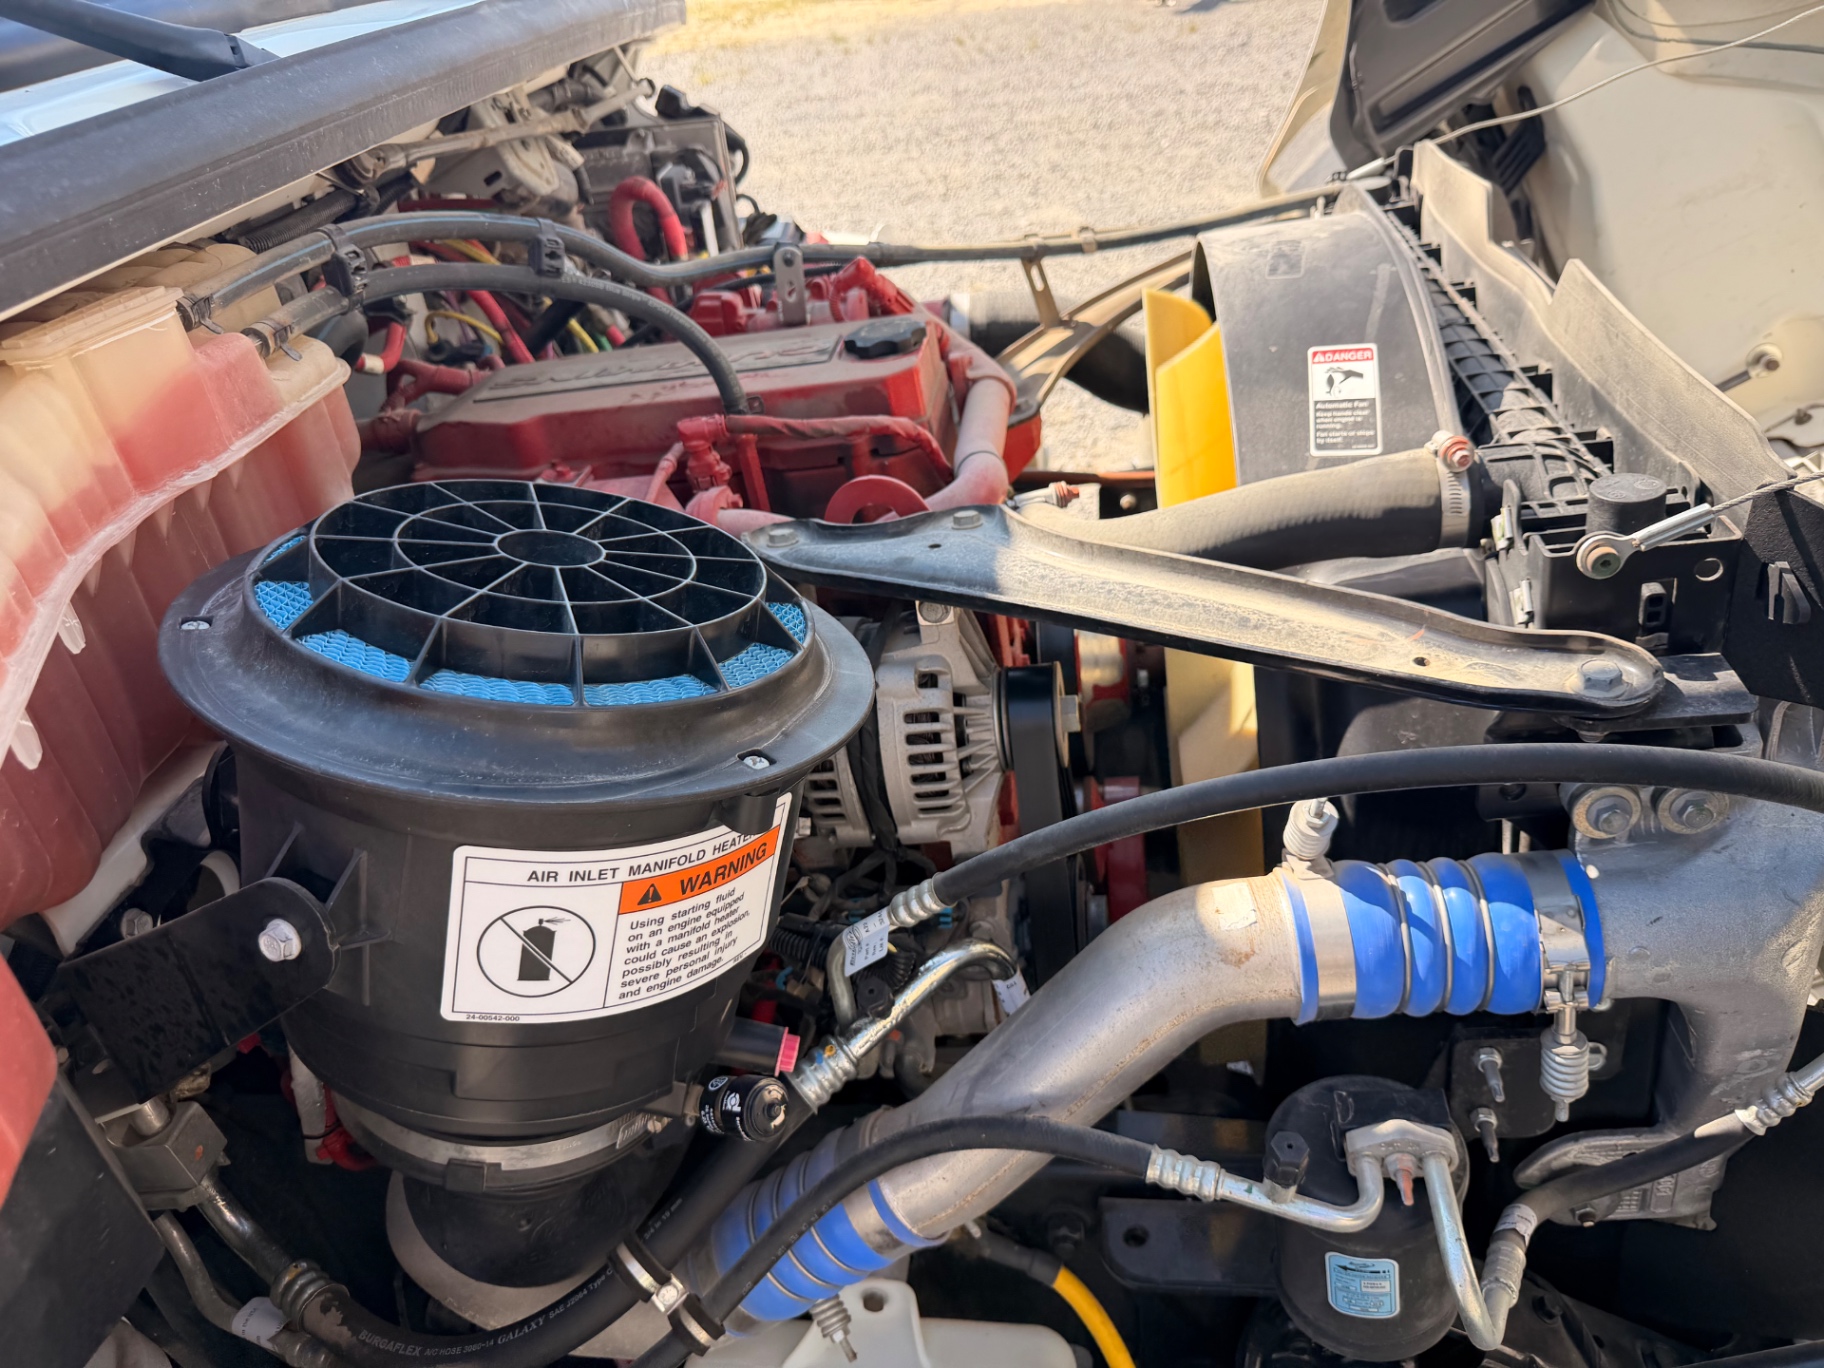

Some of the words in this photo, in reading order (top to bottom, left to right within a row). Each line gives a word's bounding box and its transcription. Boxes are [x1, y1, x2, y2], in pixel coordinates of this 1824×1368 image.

[1325, 350, 1372, 361] DANGER
[1316, 401, 1352, 409] Automatic
[527, 870, 559, 883] AIR
[569, 867, 620, 882] INLET
[628, 849, 706, 877] MANIFOLD
[712, 834, 755, 855] HEATE
[680, 842, 767, 896] WARNING
[626, 941, 650, 954] with
[668, 920, 711, 944] manifold
[714, 906, 740, 926] heater
[628, 933, 643, 942] on
[648, 928, 662, 938] an
[668, 915, 702, 932] engine
[706, 892, 744, 918] equipped
[630, 917, 664, 930] Using
[671, 901, 711, 920] starting
[716, 887, 736, 904] fluid
[620, 973, 660, 988] severe
[666, 951, 710, 977] personal
[714, 936, 738, 956] injury
[622, 957, 672, 978] possibly
[678, 936, 720, 962] resulting
[725, 930, 732, 940] in
[624, 950, 656, 966] could
[661, 940, 692, 956] cause
[696, 933, 708, 944] an
[618, 986, 640, 1000] and
[646, 975, 682, 993] engine
[686, 957, 724, 978] damage.
[466, 1014, 520, 1022] 24-00542-000
[358, 1329, 423, 1356] BURGAFLEX
[440, 1346, 462, 1356] HOSE
[498, 1314, 546, 1344] GALAXY
[548, 1304, 566, 1319] SAE
[588, 1274, 606, 1290] Type
